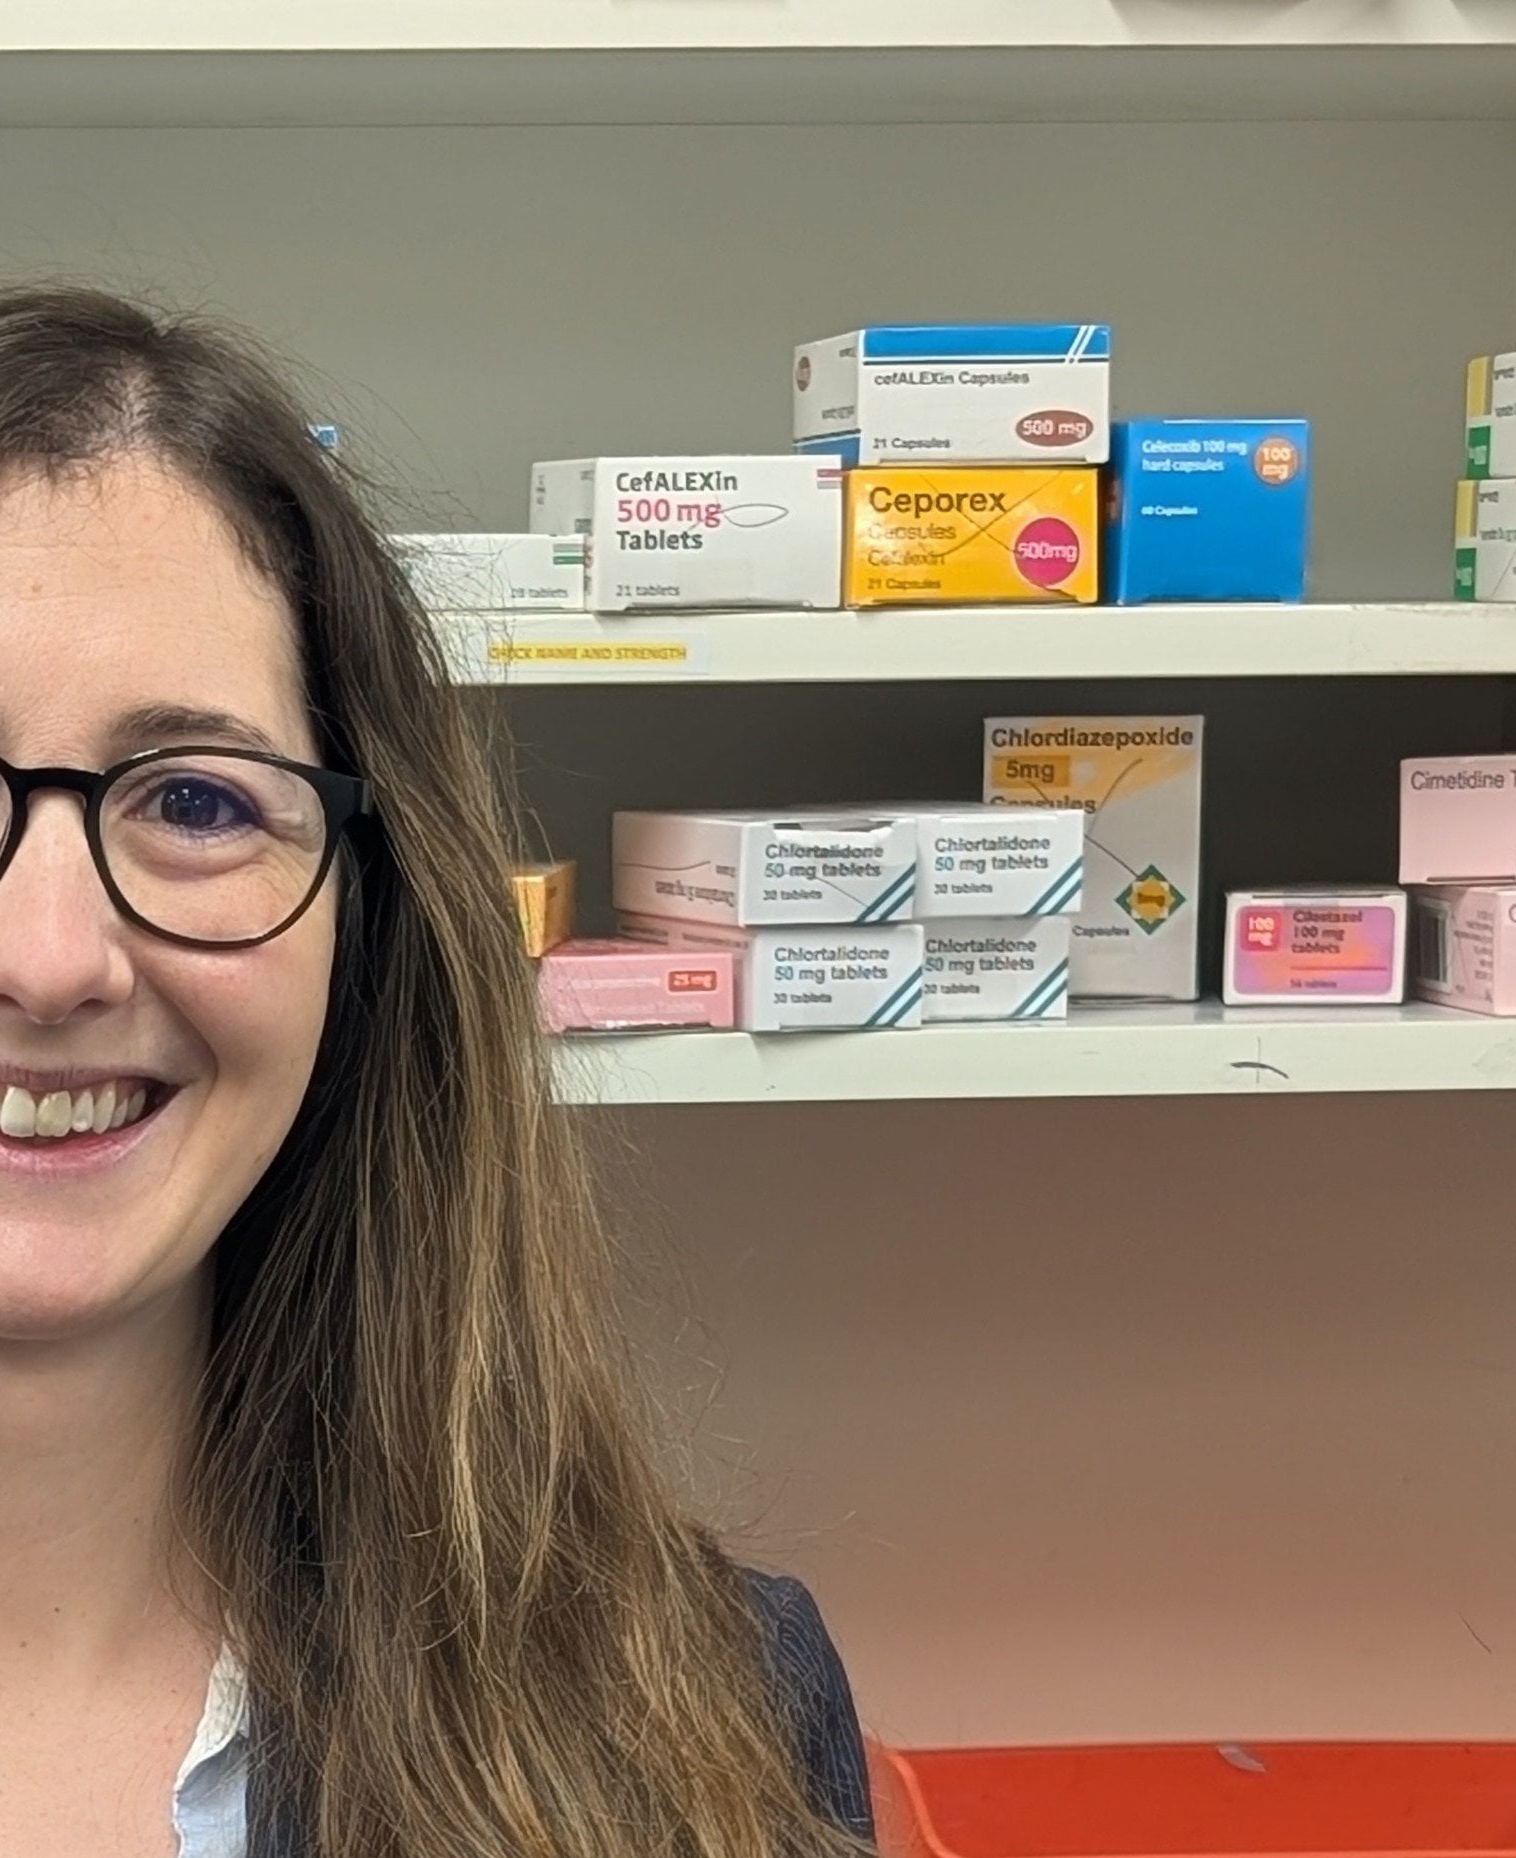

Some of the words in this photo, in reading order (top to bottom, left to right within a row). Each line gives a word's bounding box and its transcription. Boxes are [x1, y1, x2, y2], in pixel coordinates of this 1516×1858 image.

[959, 371, 1030, 387] Capsules
[1022, 420, 1053, 436] 500
[1058, 422, 1088, 439] mg
[891, 437, 951, 450] Capsules
[1262, 447, 1291, 461] 100
[1262, 464, 1289, 480] mg
[868, 486, 1008, 518] Ceporex
[617, 499, 671, 523] 500
[675, 500, 721, 528] mg
[616, 529, 704, 552] Tablets
[1018, 541, 1080, 563] 500mg
[616, 585, 632, 597] 21
[636, 585, 680, 597] tablets
[885, 577, 941, 591] Capsules
[615, 647, 688, 661] STRENGTH
[991, 727, 1194, 750] Chlordiazepoxide
[1006, 759, 1056, 783] 5mg
[1410, 770, 1504, 790] Cimetidine
[765, 842, 884, 860] Chlortalidone
[935, 836, 1051, 854] Chlortalidone
[765, 862, 786, 879] 50
[789, 865, 818, 882] mg
[821, 861, 882, 878] tablets
[935, 856, 955, 871] 50
[959, 857, 987, 874] mg
[990, 854, 1049, 870] tablets
[780, 888, 822, 900] tablets
[951, 882, 993, 894] tablets
[1072, 925, 1131, 938] Capsules
[774, 946, 890, 963] Chlortalidone
[925, 938, 1038, 955] Chlortalidone
[774, 965, 794, 981] 50
[798, 967, 826, 985] mg
[830, 963, 888, 980] tablets
[925, 957, 944, 972] 50
[947, 959, 975, 975] mg
[979, 956, 1034, 971] tablets
[790, 992, 832, 1004] tablets
